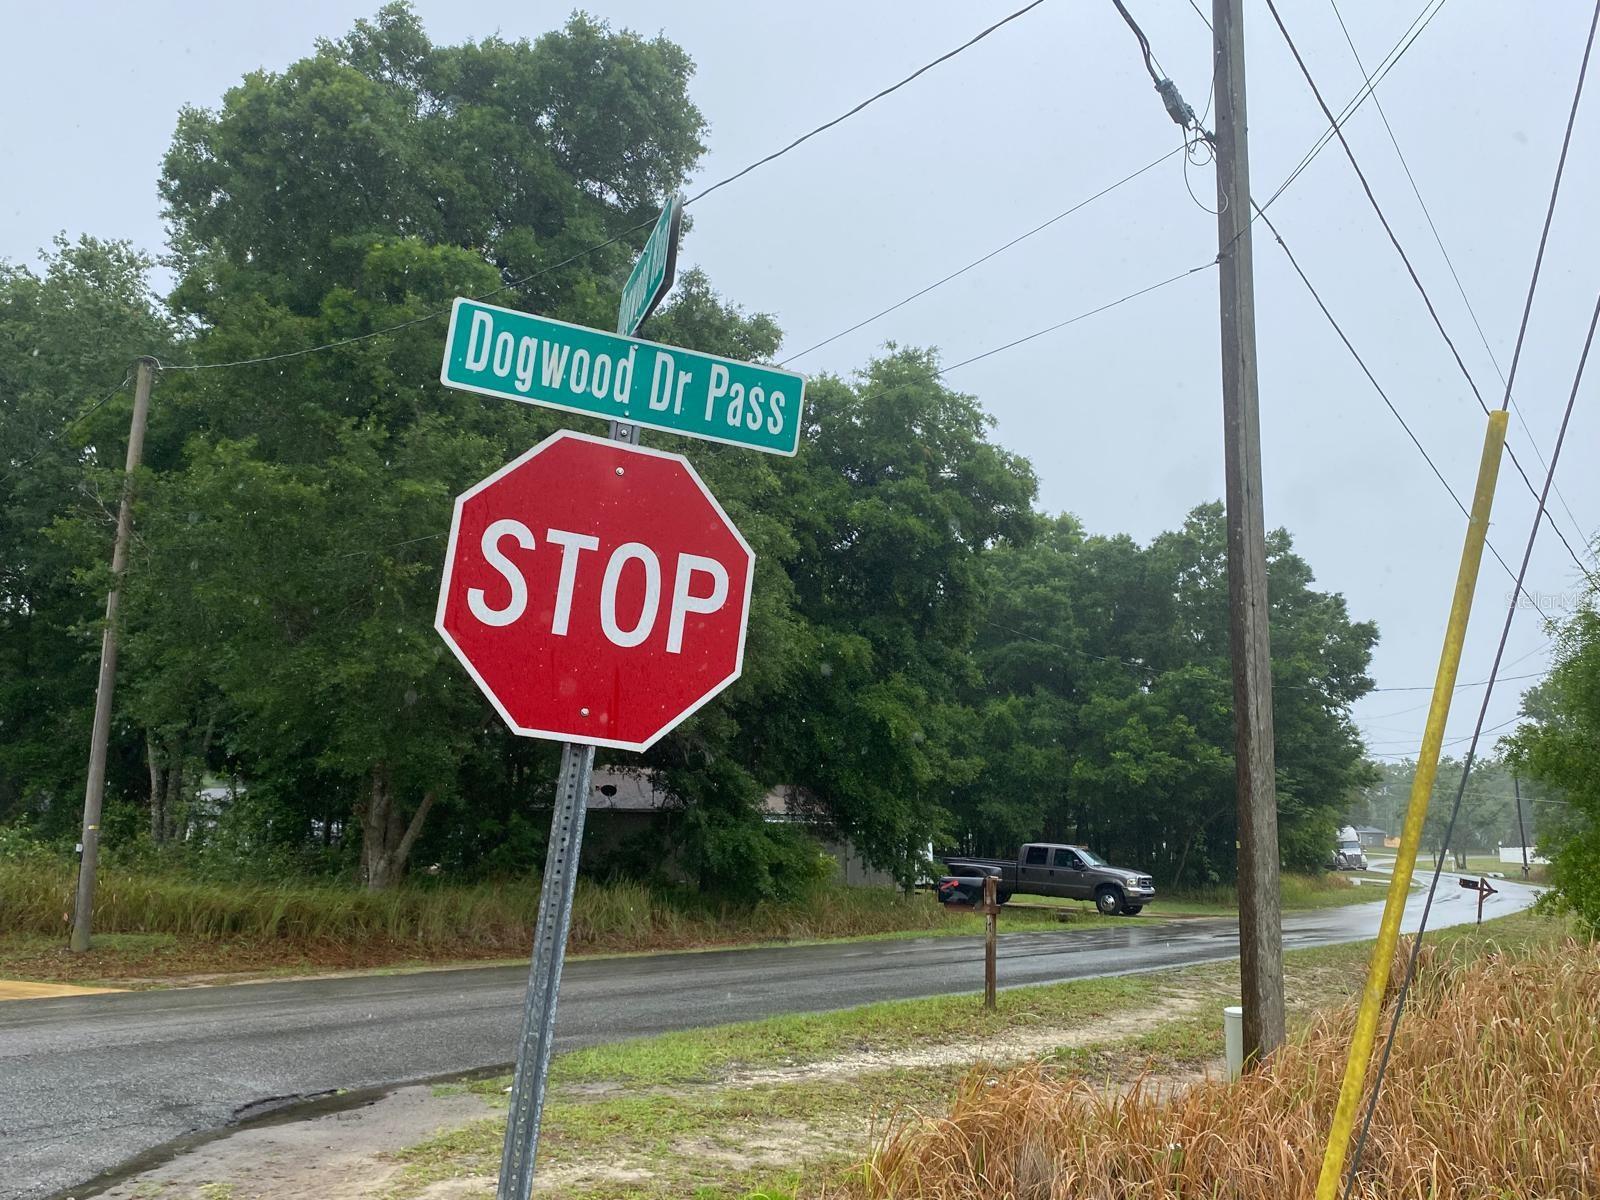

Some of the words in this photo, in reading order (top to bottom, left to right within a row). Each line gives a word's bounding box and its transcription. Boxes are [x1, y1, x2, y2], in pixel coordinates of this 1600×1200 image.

[464, 310, 635, 404] Dogwood
[649, 351, 692, 414] Dr
[704, 364, 786, 434] Pass
[467, 519, 729, 654] STOP
